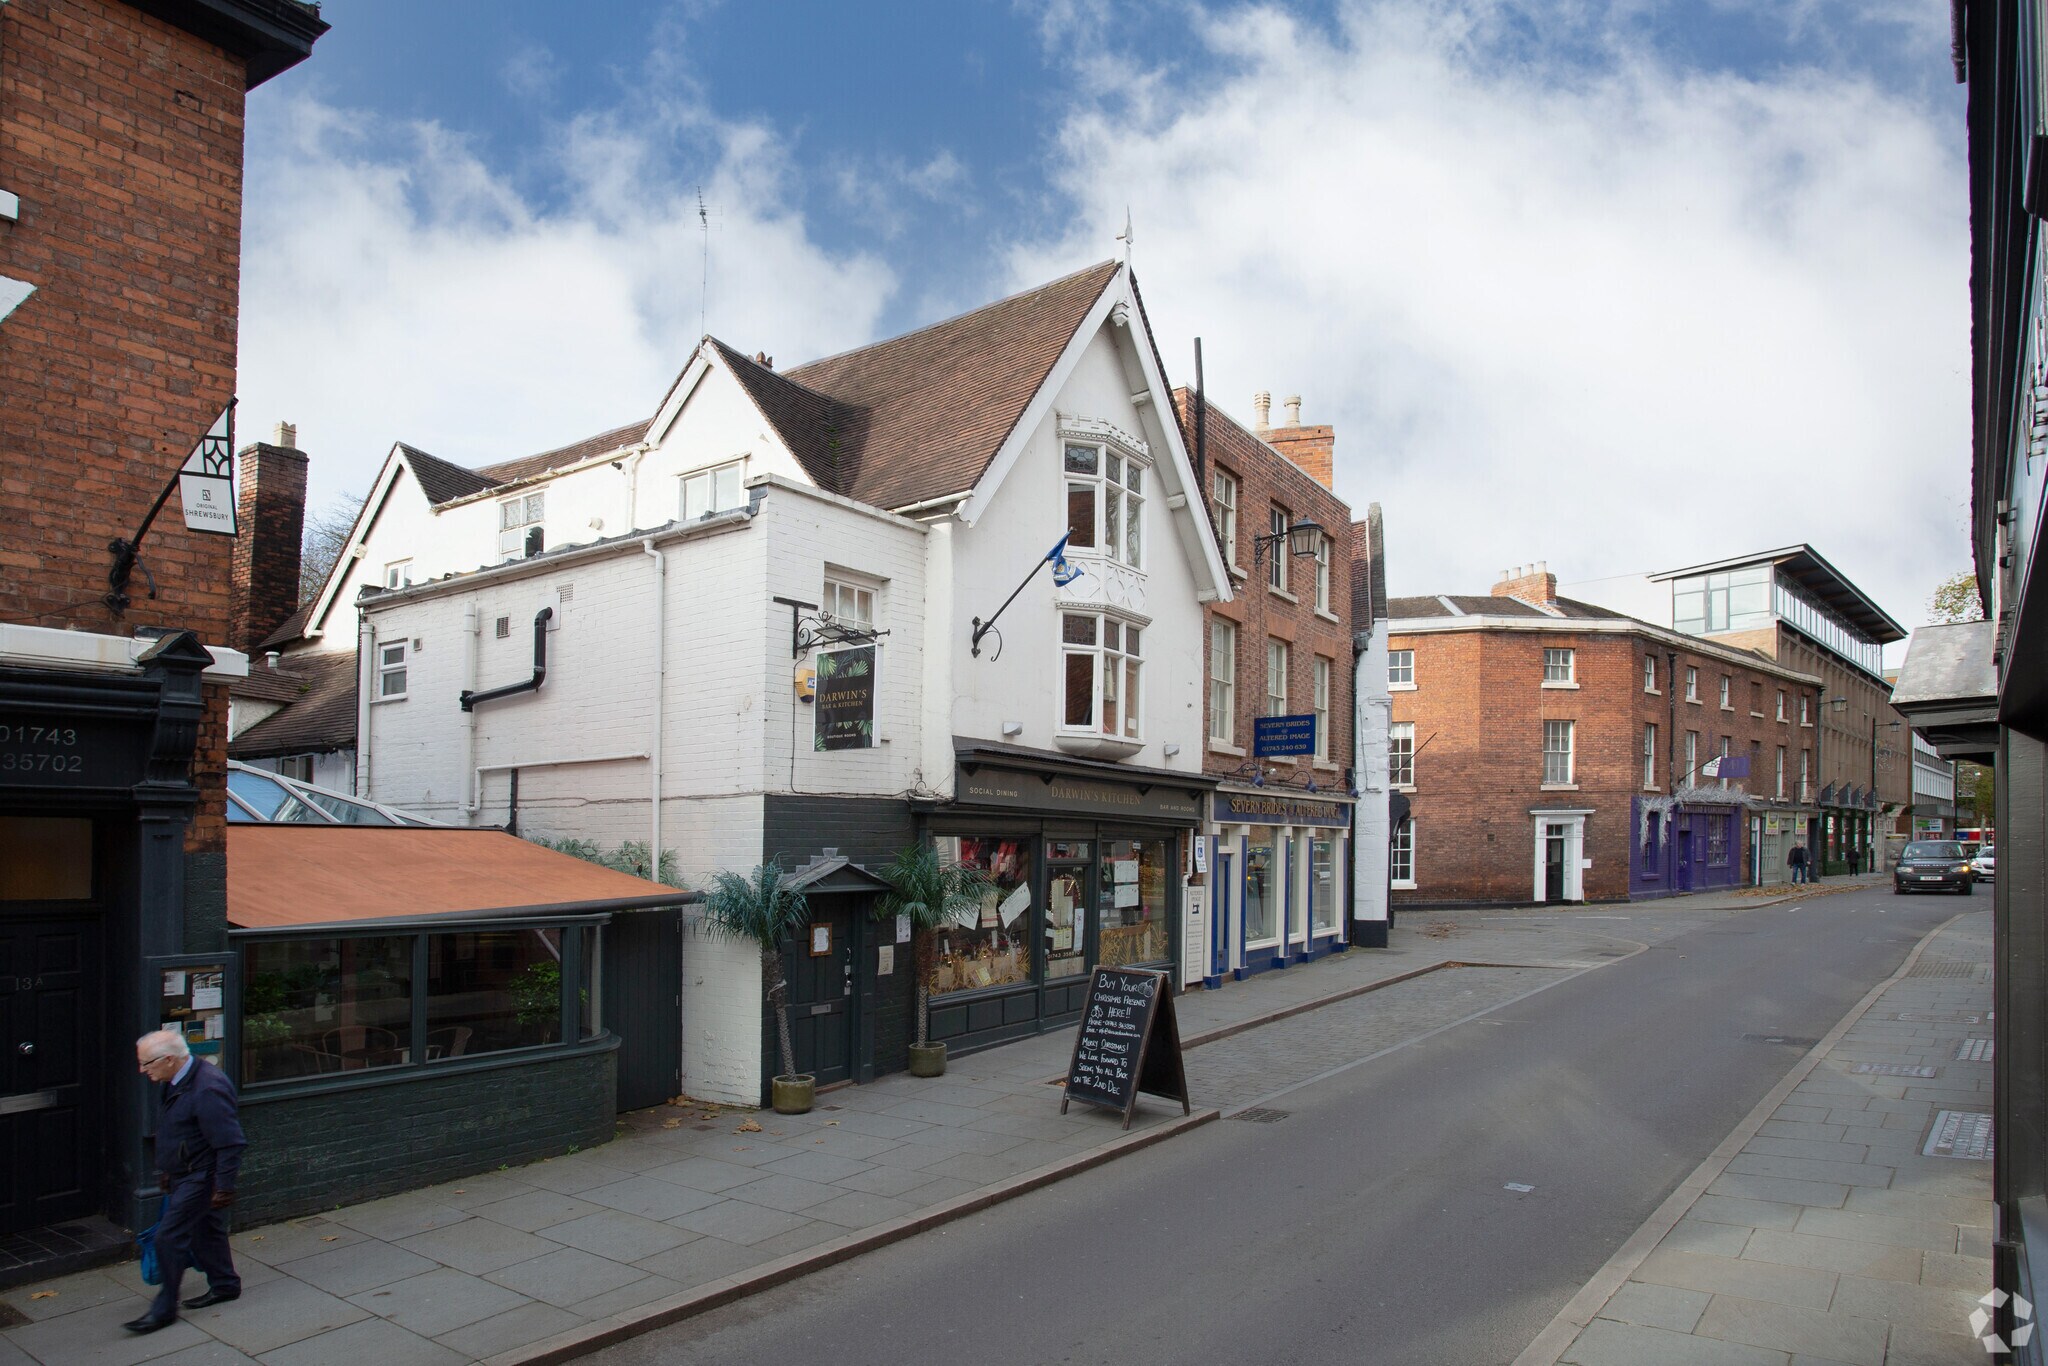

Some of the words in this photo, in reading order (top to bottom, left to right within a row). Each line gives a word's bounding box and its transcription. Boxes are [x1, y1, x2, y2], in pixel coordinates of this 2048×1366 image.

[185, 509, 229, 521] SHREWSBURY
[820, 689, 867, 703] DARWIN'S
[838, 700, 864, 708] KITCHEN
[1286, 720, 1310, 728] BRIDES
[0, 725, 76, 746] 01743
[969, 786, 993, 796] SOCIAL
[996, 789, 1018, 798] DINING
[1051, 786, 1099, 801] DARWIN'S
[1101, 791, 1141, 806] KITCHEN
[1230, 799, 1260, 814] SEVERN
[1261, 801, 1287, 816] BRIDES
[1296, 804, 1323, 817] ALTERED
[1099, 973, 1116, 990] BUY
[1120, 976, 1138, 992] YOUR
[1094, 992, 1121, 1004] CHRISTMAS
[1123, 995, 1147, 1008] PRESENTS
[1082, 1037, 1098, 1047] MERRY
[1079, 1050, 1086, 1059] WE
[1088, 1051, 1098, 1061] LOOK
[1120, 1058, 1128, 1067] TO
[1078, 1062, 1093, 1074] SEEING
[1095, 1065, 1103, 1074] YOU
[1104, 1067, 1114, 1076] ALL
[1115, 1067, 1129, 1080] BACK
[1082, 1076, 1091, 1085] THE
[1107, 1080, 1120, 1095] DEC
